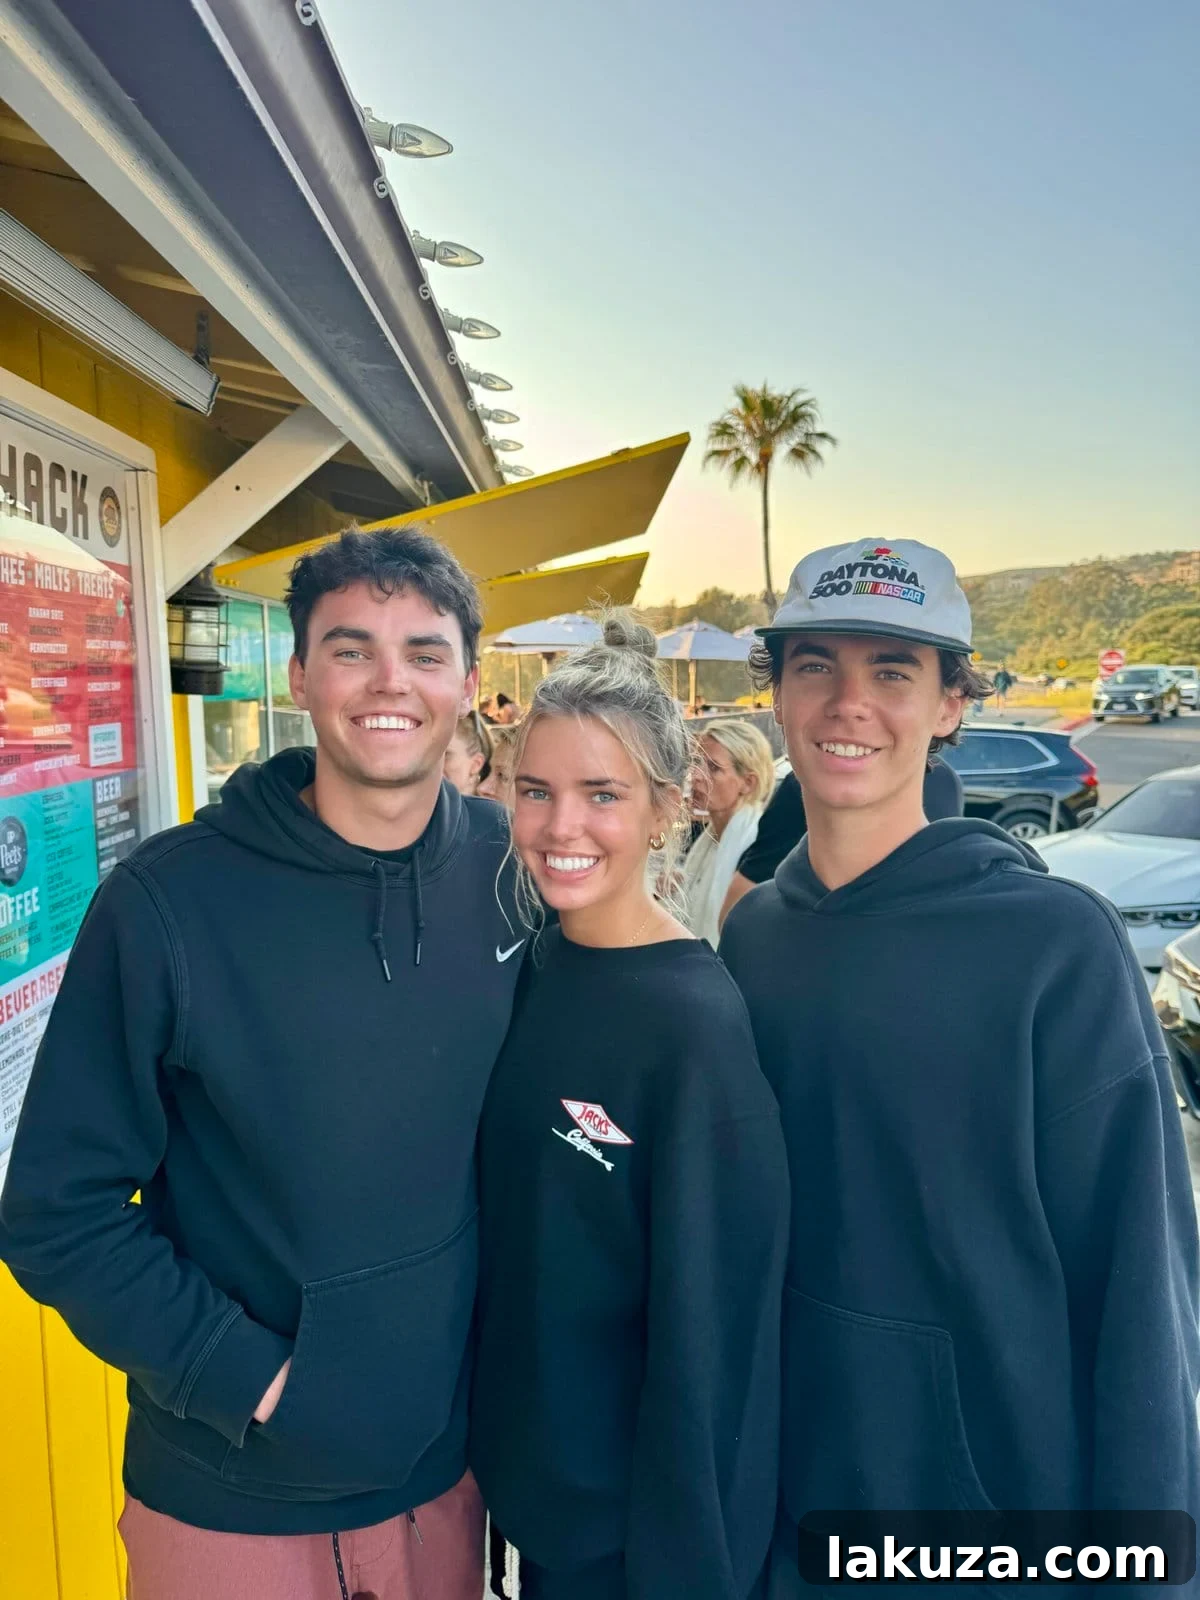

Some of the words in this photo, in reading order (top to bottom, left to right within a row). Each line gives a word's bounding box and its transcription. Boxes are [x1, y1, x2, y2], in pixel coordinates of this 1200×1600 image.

[35, 562, 71, 593] MALTS
[77, 571, 114, 599] TREATS
[816, 562, 920, 587] DAYTONA
[809, 580, 853, 599] 500
[878, 581, 921, 603] NASCAR
[95, 776, 121, 804] BEER
[0, 961, 68, 1026] BEVERAGE
